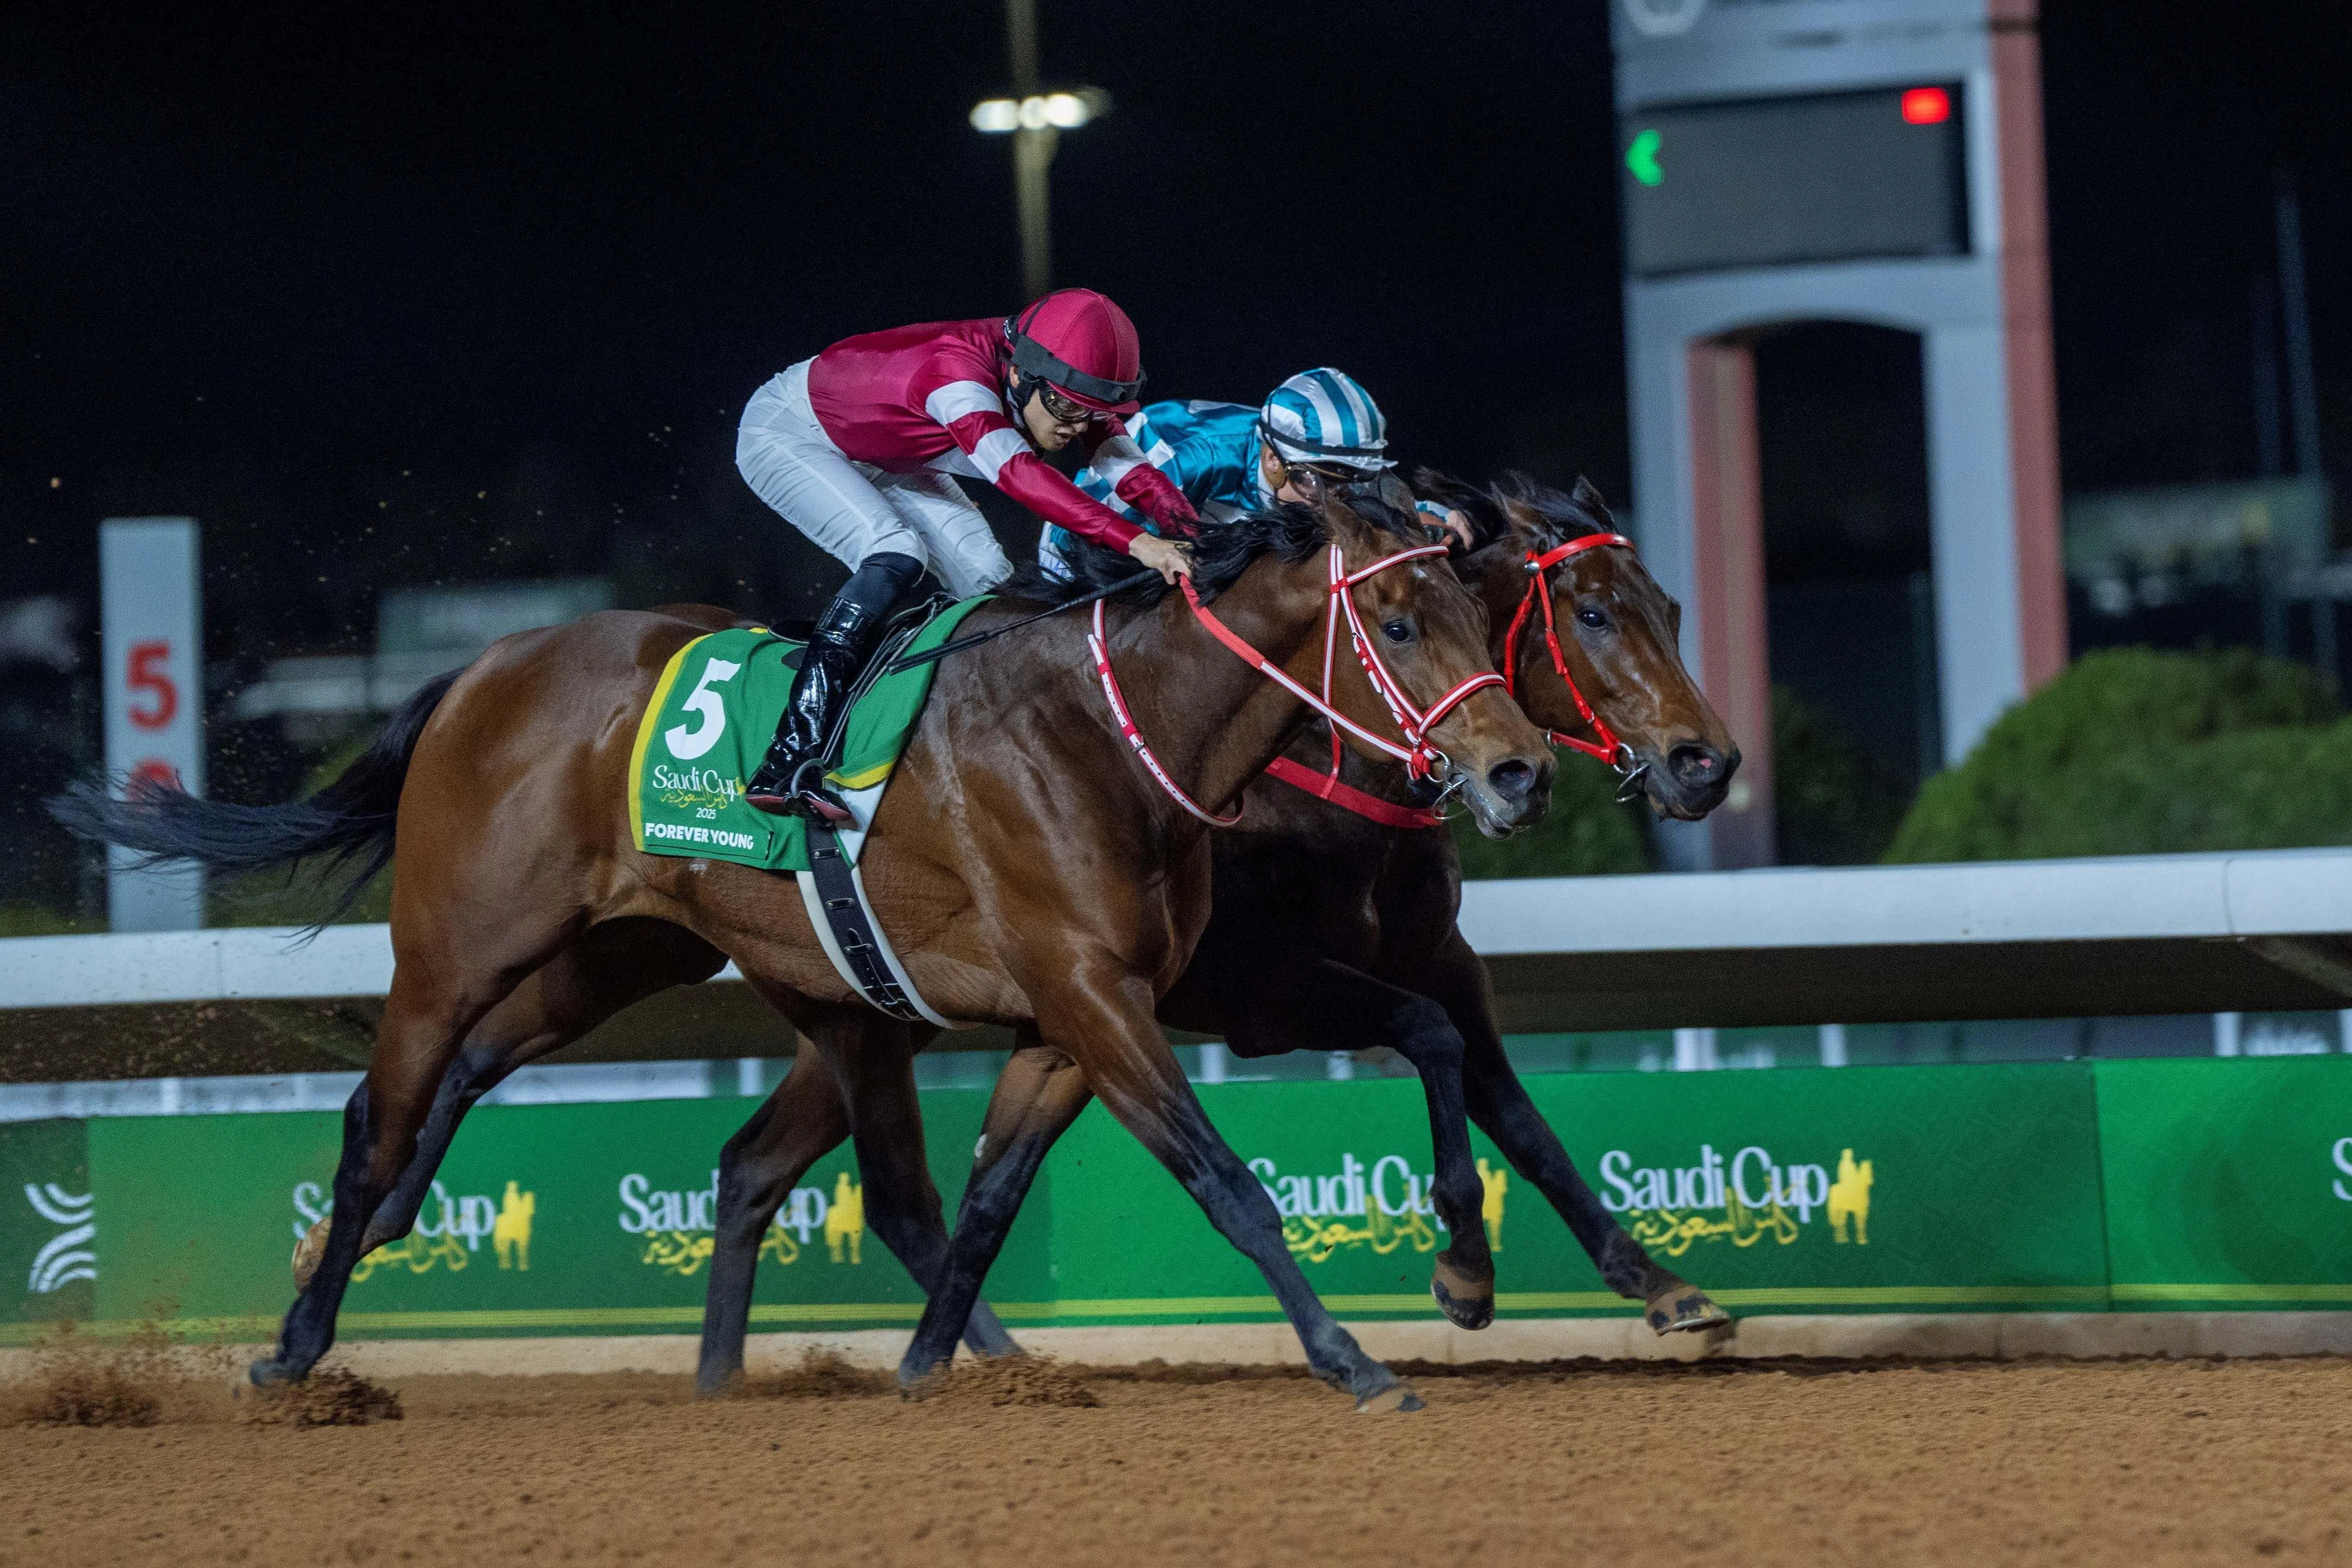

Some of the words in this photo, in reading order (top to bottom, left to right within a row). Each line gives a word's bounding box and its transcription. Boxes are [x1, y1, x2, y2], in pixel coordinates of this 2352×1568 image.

[665, 657, 741, 760] 5
[653, 764, 701, 792] Saudi
[702, 770, 739, 802] Cup
[696, 807, 716, 820] 2025
[645, 823, 708, 843] FOREVER
[709, 829, 754, 850] YOUNG
[619, 1169, 720, 1233] Saud
[774, 1187, 828, 1244] up
[1372, 1155, 1447, 1231] Cu
[1599, 1144, 1726, 1212] Saudi
[1731, 1146, 1829, 1224] Cup
